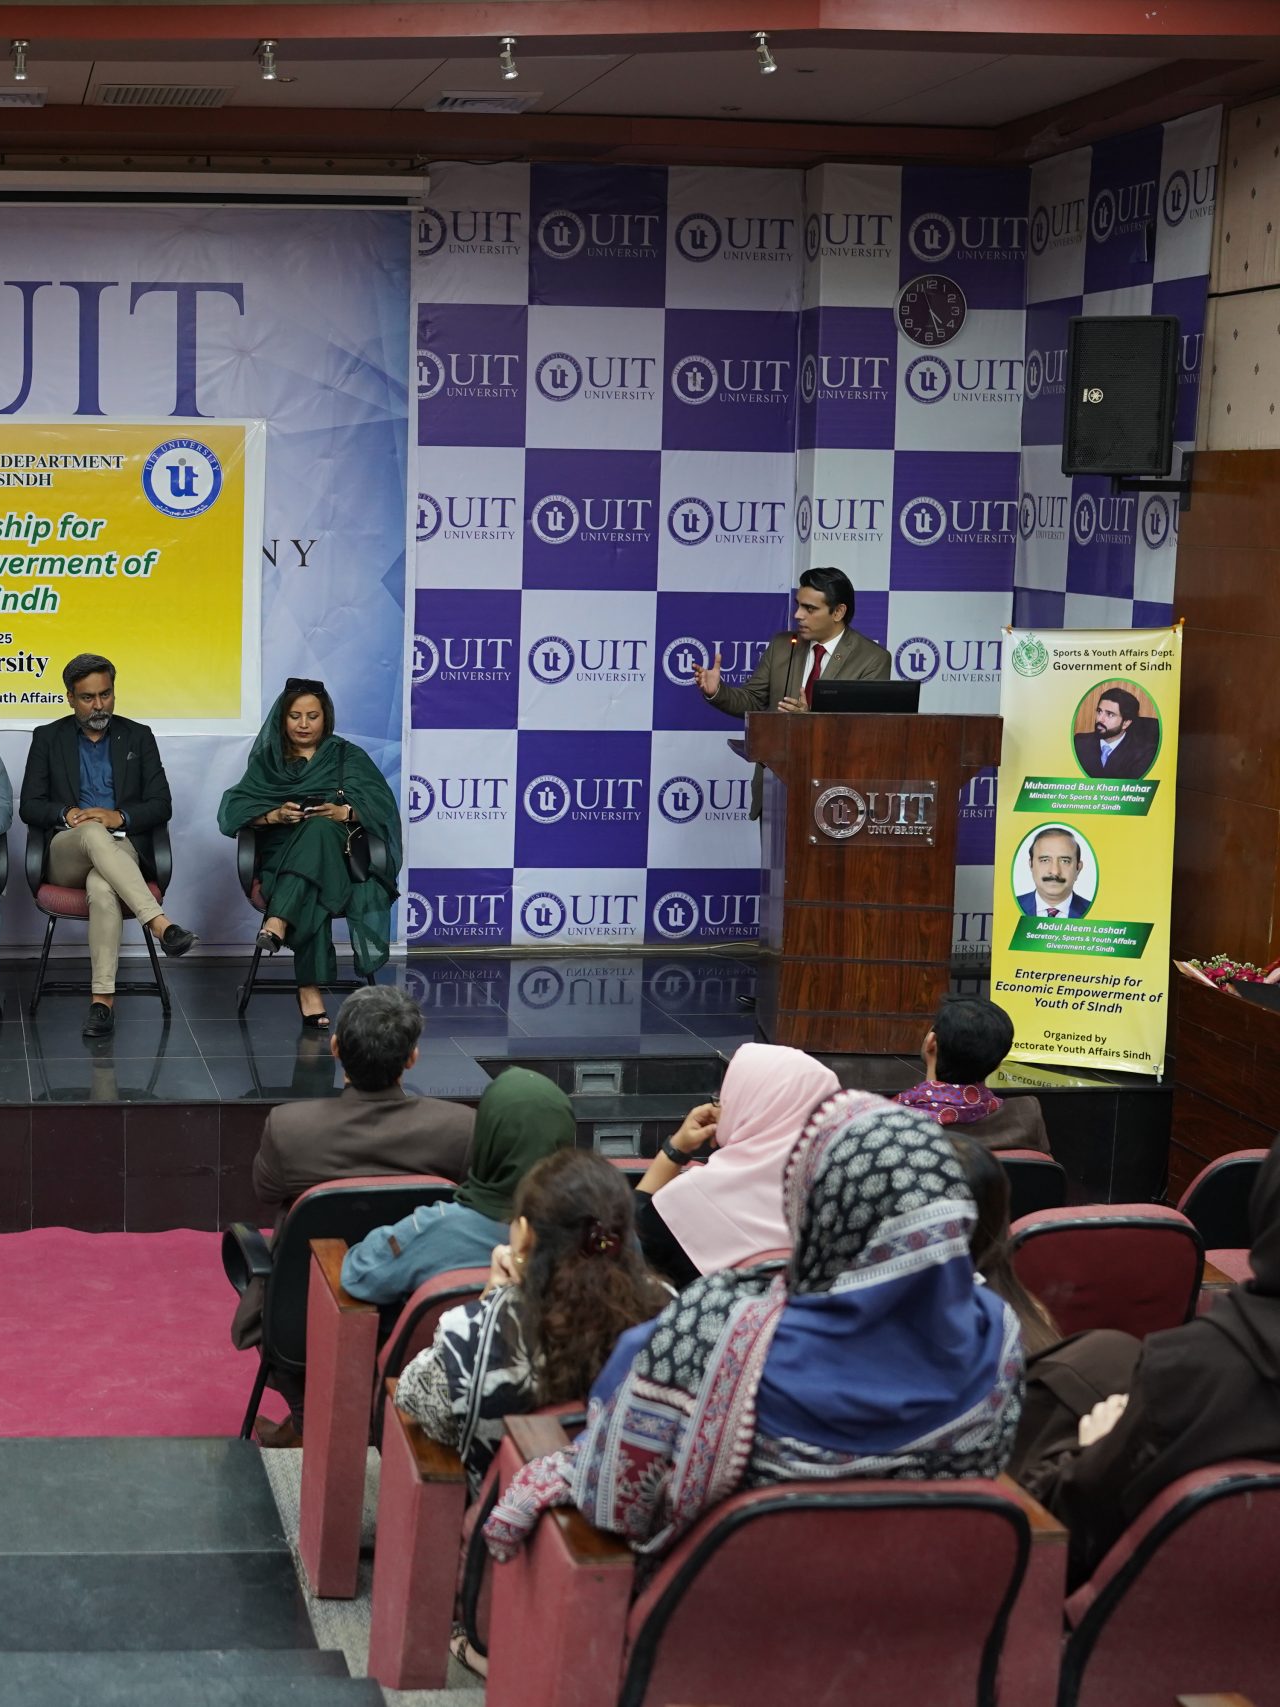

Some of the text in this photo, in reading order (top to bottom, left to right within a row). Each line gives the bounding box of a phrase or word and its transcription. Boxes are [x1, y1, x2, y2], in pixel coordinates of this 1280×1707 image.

[587, 214, 659, 246] UIT
[821, 214, 892, 246] UIT
[587, 248, 658, 258] UNIVERSITY
[821, 248, 892, 258] UNIVERSITY
[1, 455, 124, 468] DEPARTMENT
[146, 440, 219, 473] UIT UNIVERSITY
[718, 501, 785, 533] UIT
[59, 514, 104, 538] for
[715, 534, 785, 545] UNIVERSITY
[125, 552, 157, 576] of
[577, 640, 647, 670] UIT
[1053, 649, 1174, 658] Sports & Youth Affairs Dept.
[1053, 662, 1172, 671] Government of Sindh
[576, 672, 647, 682] UNIVERSITY
[20, 692, 64, 703] Affairs
[572, 779, 642, 809] UIT
[1024, 782, 1151, 793] Muhammad Bux Khan Mahar
[1070, 794, 1092, 802] Sports
[866, 792, 933, 824] UIT
[571, 811, 642, 821] UNIVERSITY
[868, 826, 932, 835] UNIVERSITY
[1037, 922, 1126, 935] Abdul Aleem Lashari
[1026, 933, 1061, 941] Secretary,
[1092, 936, 1112, 944] Youth
[1015, 969, 1142, 988] Enterpreneurship for
[995, 982, 1163, 1002] Economic Empowerment of
[1035, 998, 1068, 1009] Youth
[1072, 1001, 1085, 1010] of
[1044, 1030, 1106, 1044] Organized by
[1057, 1044, 1085, 1055] Youth
[1088, 1047, 1121, 1057] Affairs
[1123, 1050, 1151, 1061] Sindh
